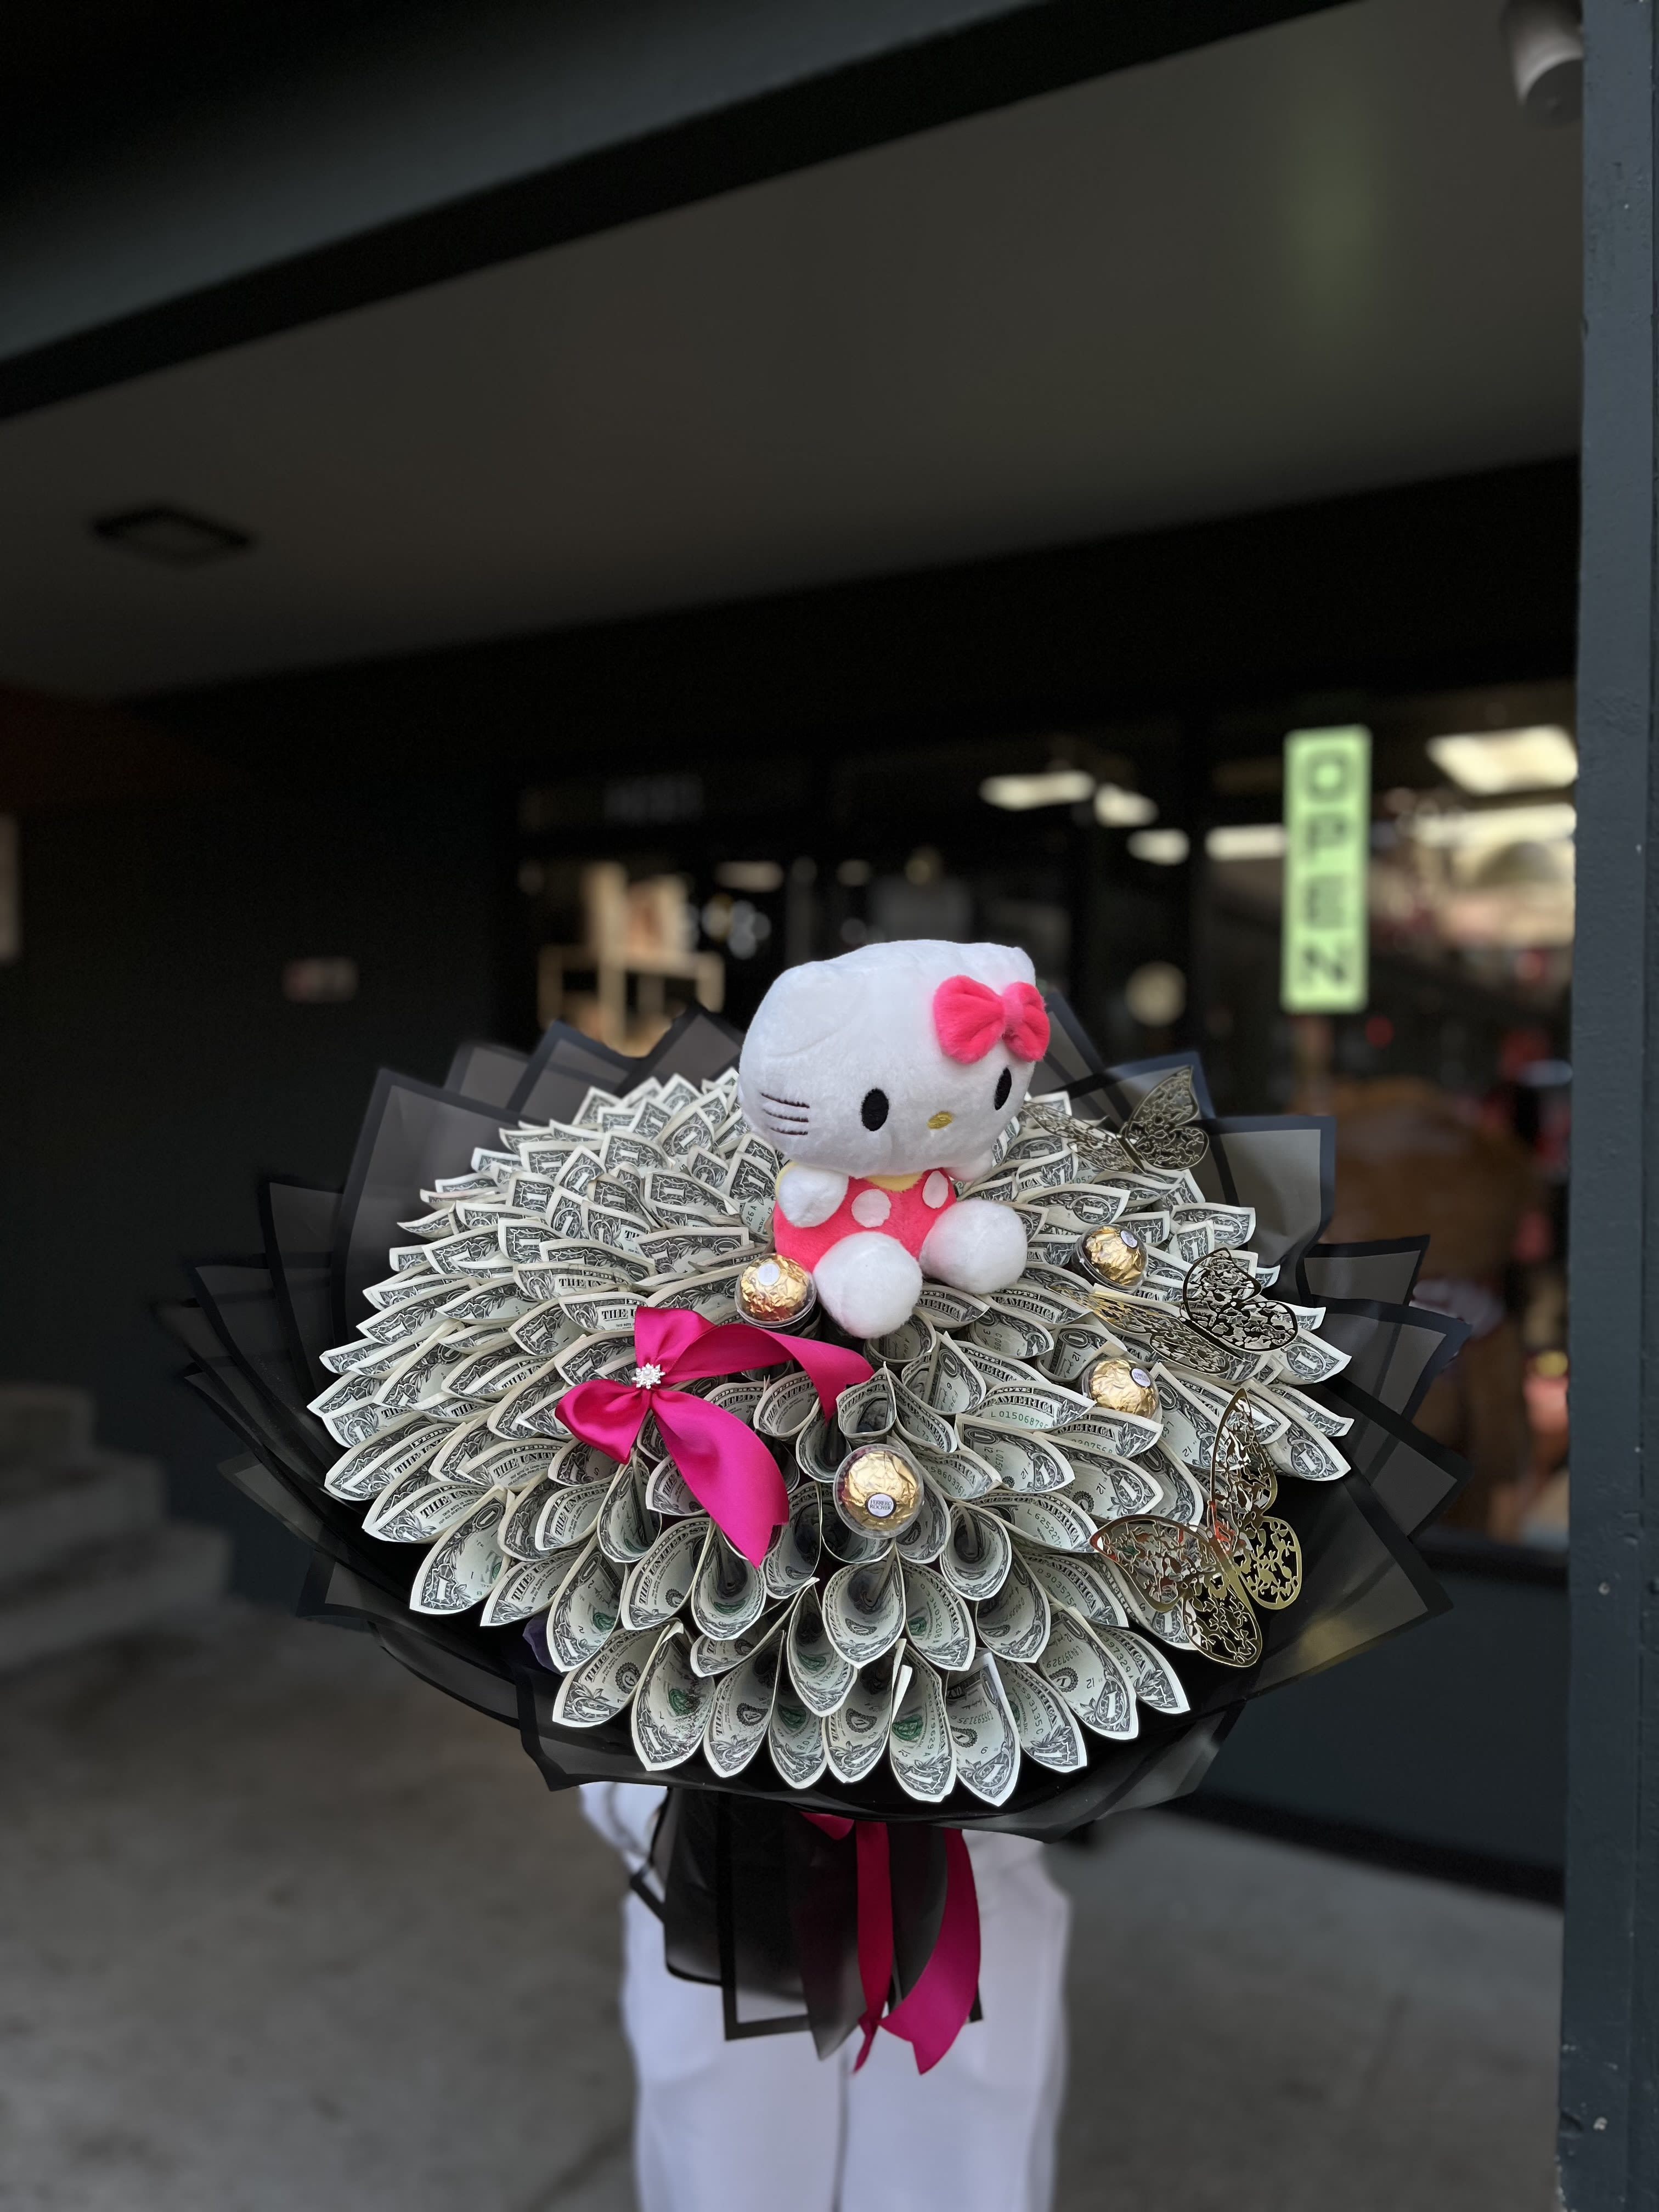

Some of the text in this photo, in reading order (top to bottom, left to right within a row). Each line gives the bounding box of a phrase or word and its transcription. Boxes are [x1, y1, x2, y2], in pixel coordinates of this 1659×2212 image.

[1300, 747, 1352, 986] OPEN
[558, 1278, 585, 1288] THE
[1005, 1290, 1037, 1300] NOTE
[601, 1308, 627, 1321] THE
[1002, 1297, 1056, 1323] AMERICA
[967, 1350, 1001, 1365] NOTE
[766, 1404, 778, 1426] THE
[996, 1395, 1055, 1418] AMERICA
[394, 1452, 421, 1475] THE
[494, 1458, 520, 1477] THE
[663, 1473, 677, 1498] THE
[420, 1496, 450, 1519] THE
[555, 1512, 568, 1537] THE
[1035, 1499, 1080, 1546] AMERICA
[639, 1575, 652, 1605] THE
[650, 1532, 689, 1576] UNITED
[511, 1573, 534, 1601] THE
[1048, 1562, 1097, 1613] AMERICA
[585, 1654, 609, 1683] THE
